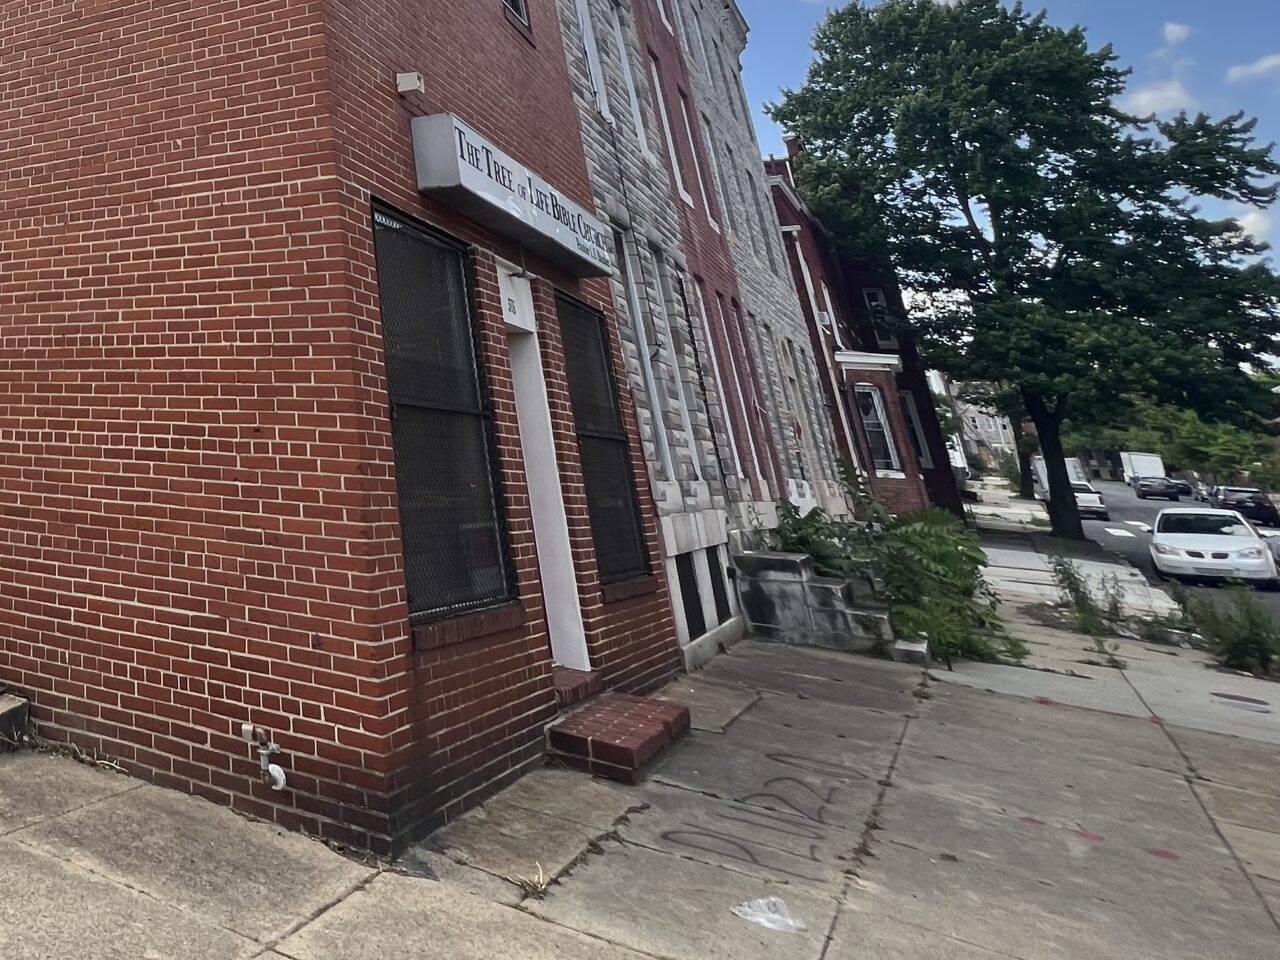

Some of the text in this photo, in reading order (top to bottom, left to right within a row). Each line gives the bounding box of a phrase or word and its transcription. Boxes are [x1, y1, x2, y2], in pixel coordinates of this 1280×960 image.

[455, 126, 482, 172] THE
[482, 145, 515, 193] TREE
[526, 176, 551, 216] LIFE
[550, 192, 578, 235] BIBLE
[578, 213, 608, 251] CHURCH
